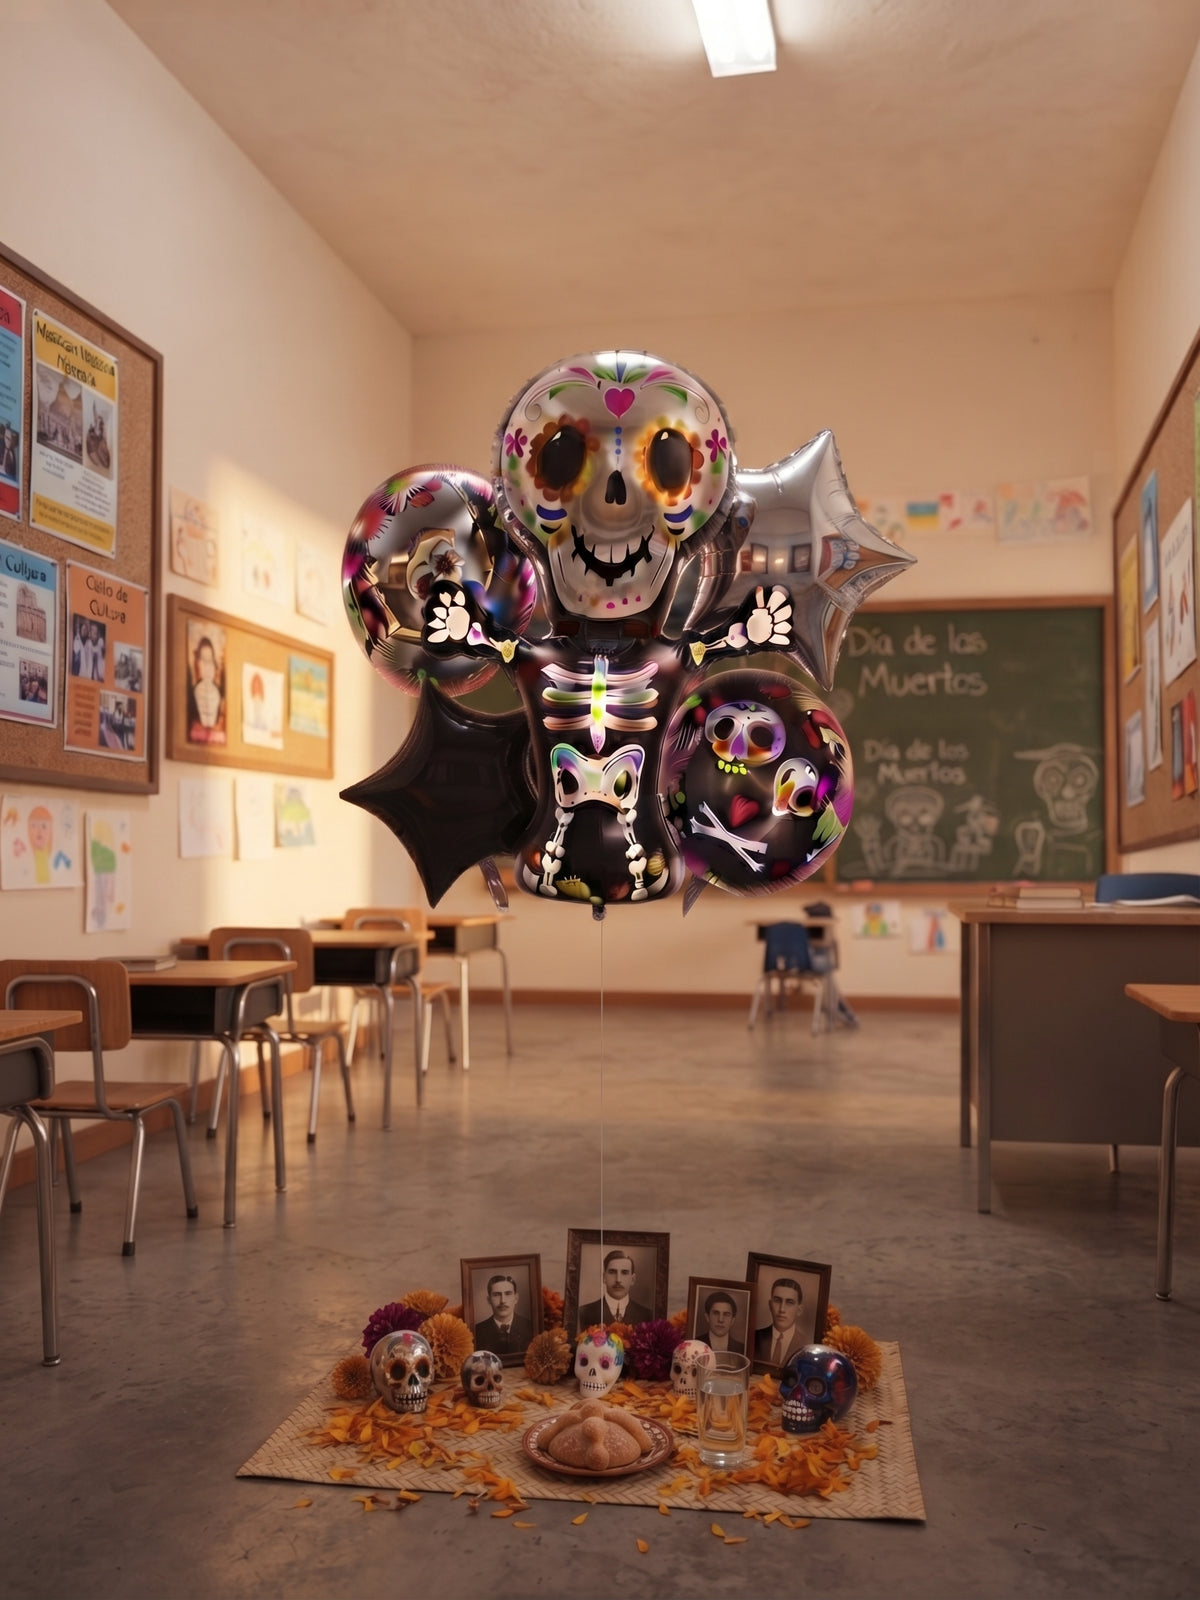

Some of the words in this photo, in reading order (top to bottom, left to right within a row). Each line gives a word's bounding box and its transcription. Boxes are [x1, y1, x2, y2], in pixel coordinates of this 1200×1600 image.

[904, 624, 936, 656] de
[948, 622, 988, 655] los
[858, 661, 989, 698] Muertos
[905, 738, 932, 761] de
[938, 737, 970, 761] los
[877, 760, 967, 786] Muertos
